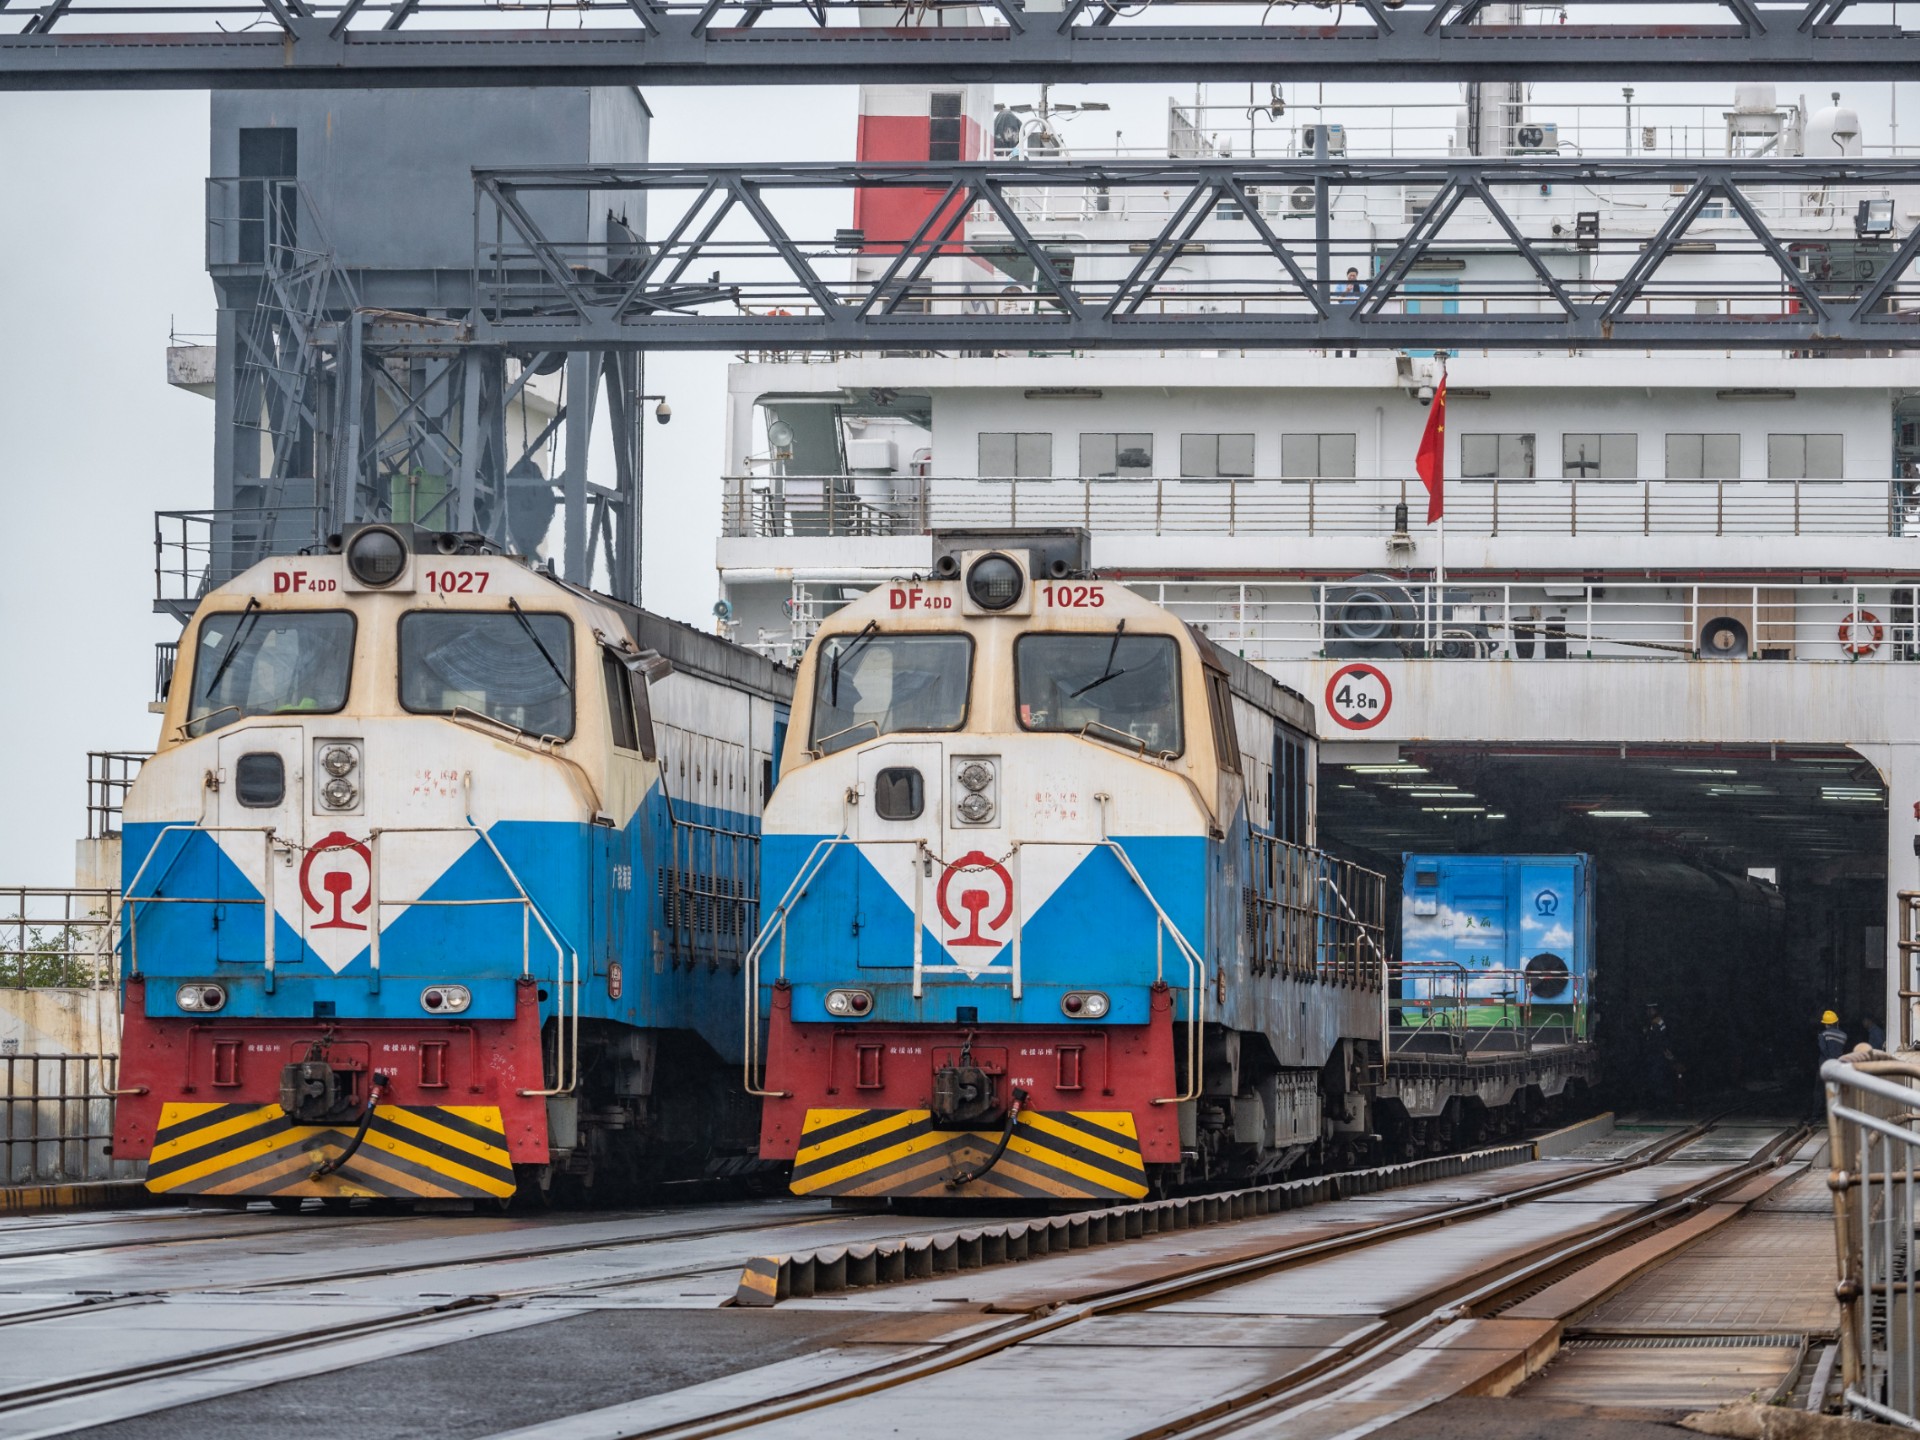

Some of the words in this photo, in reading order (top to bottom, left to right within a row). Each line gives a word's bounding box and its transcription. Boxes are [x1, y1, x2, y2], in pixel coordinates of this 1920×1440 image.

[274, 571, 336, 593] DF4DD
[426, 571, 489, 593] 1027
[890, 588, 952, 609] DF4DD
[1043, 586, 1104, 607] 1025
[1335, 685, 1377, 709] 4.8m
